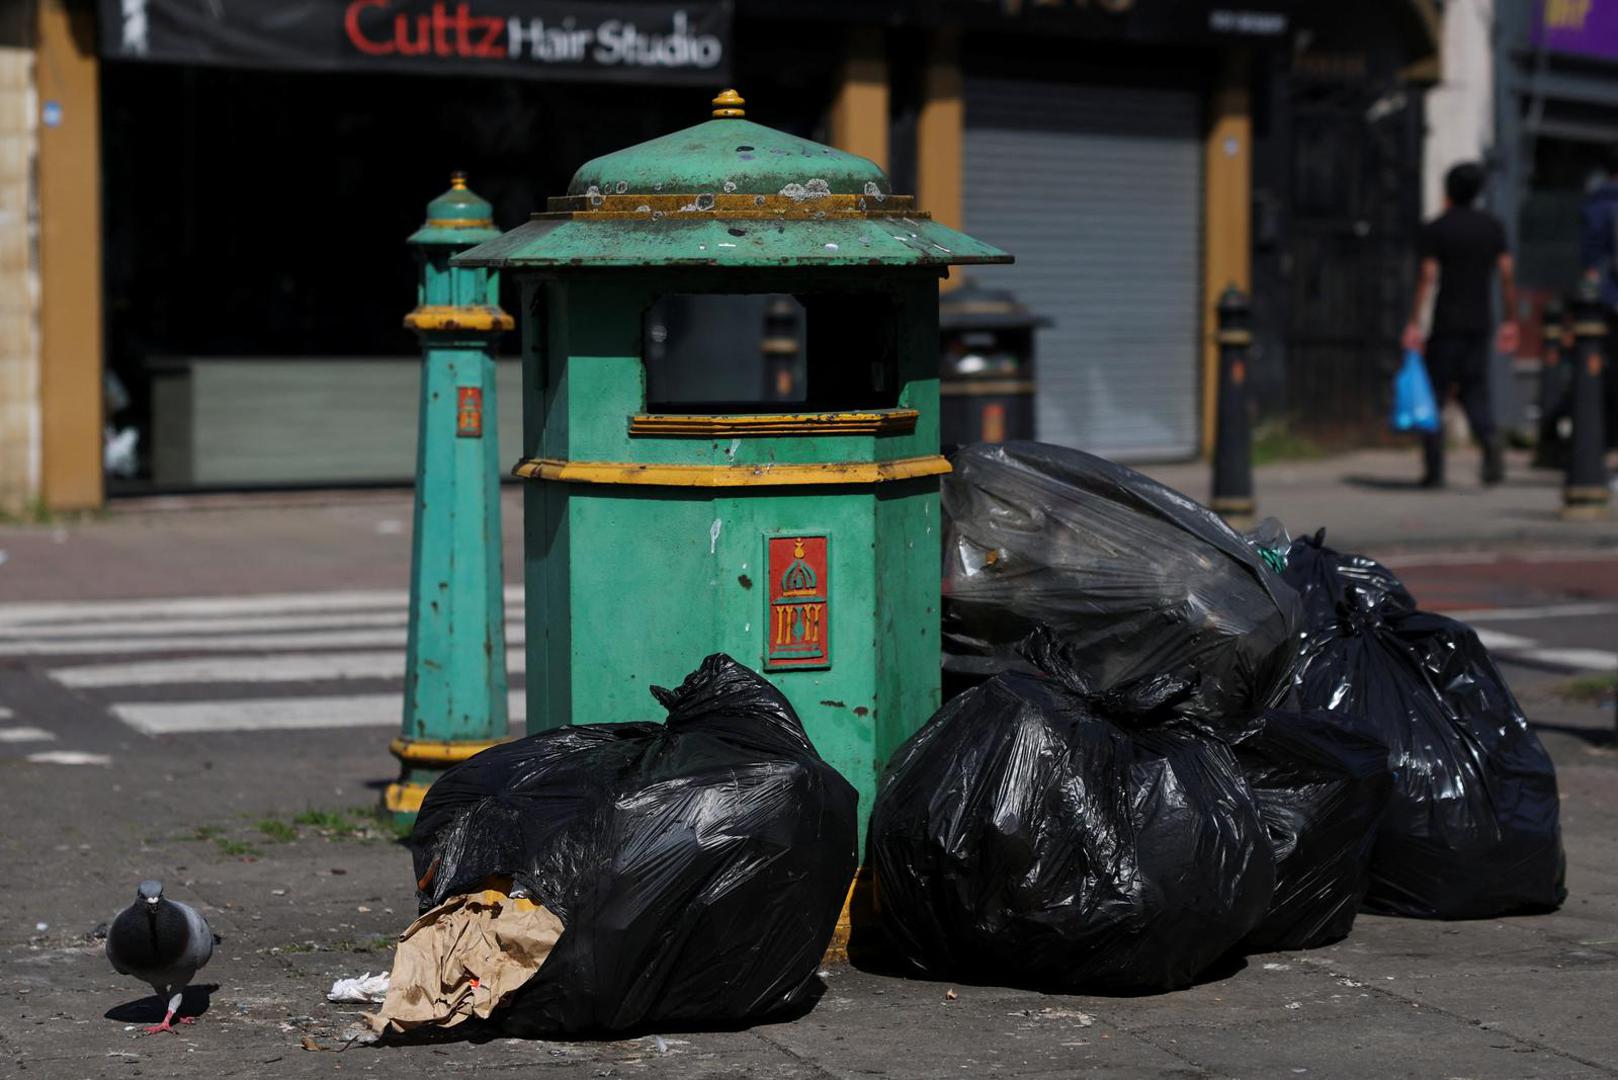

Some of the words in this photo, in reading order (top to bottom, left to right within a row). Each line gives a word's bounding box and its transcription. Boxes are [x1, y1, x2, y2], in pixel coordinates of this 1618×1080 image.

[344, 0, 505, 57] Cuttz
[507, 16, 593, 62] Hair
[593, 10, 722, 68] Studio
